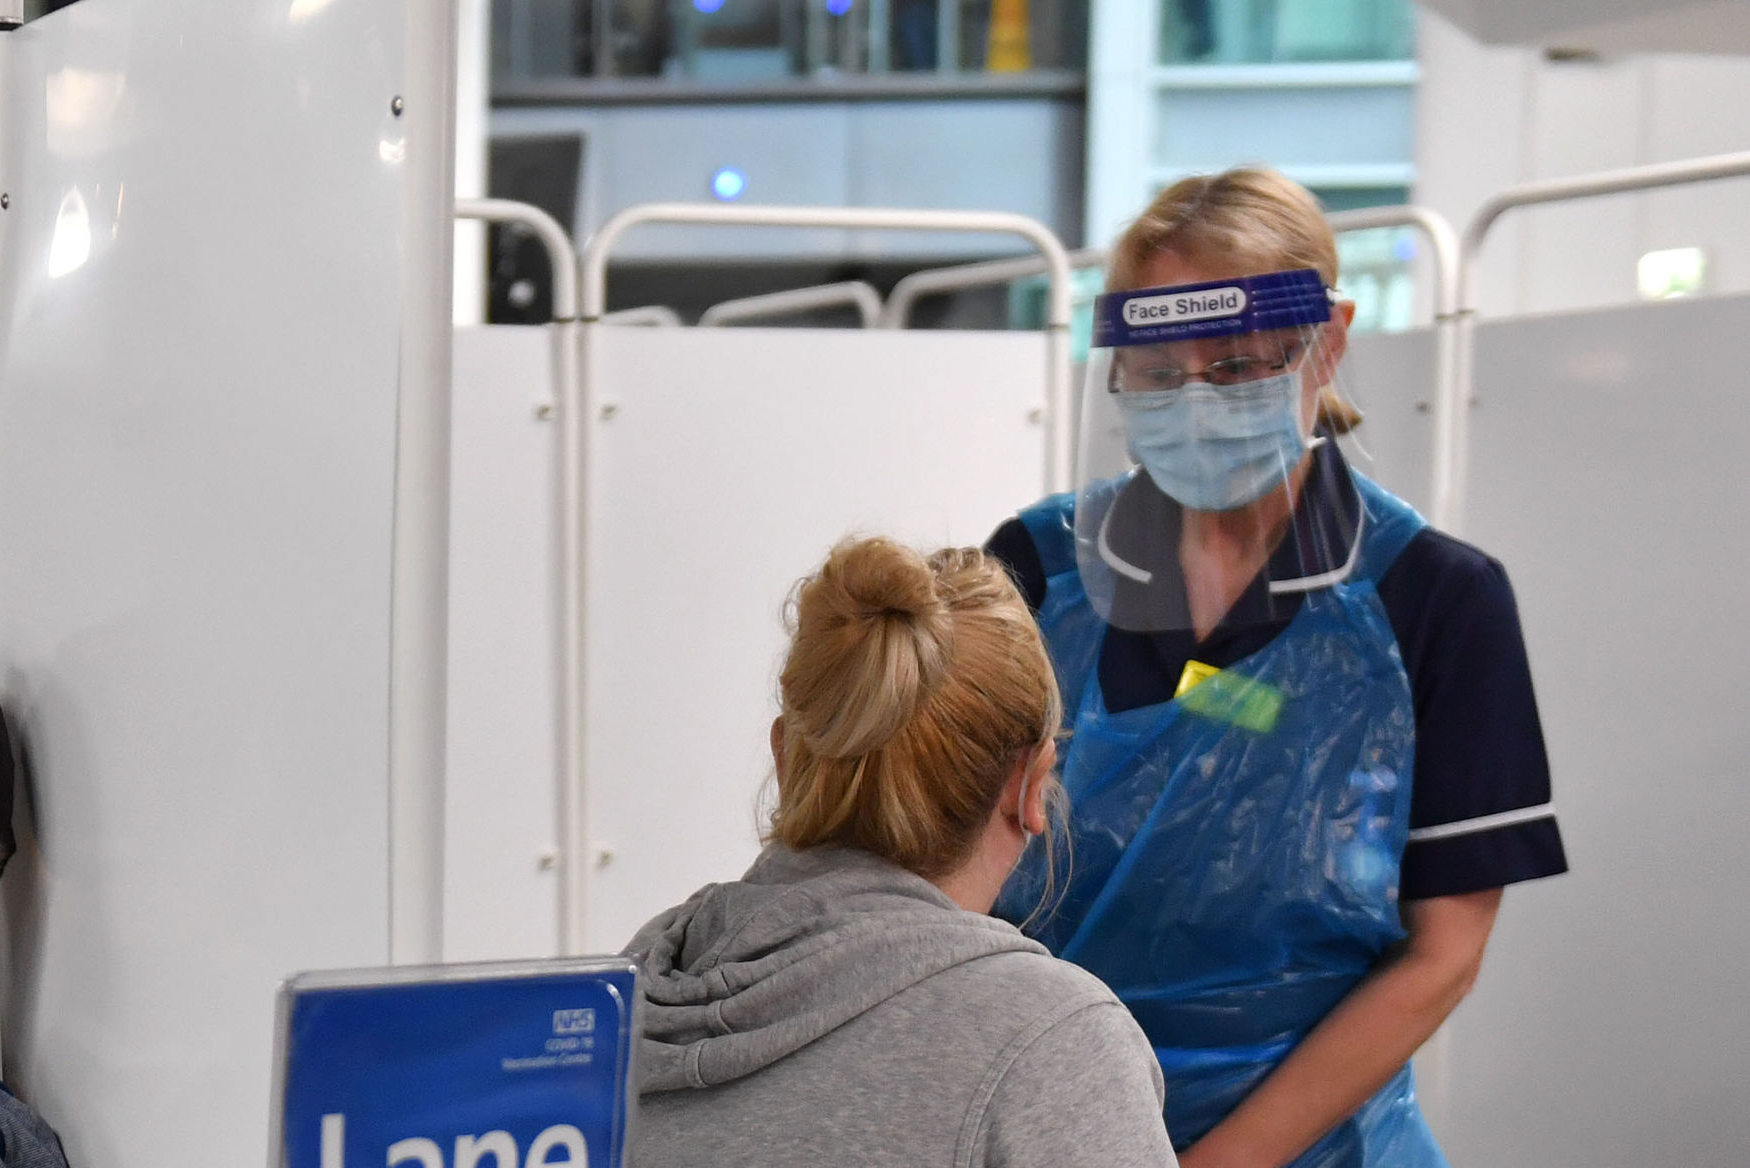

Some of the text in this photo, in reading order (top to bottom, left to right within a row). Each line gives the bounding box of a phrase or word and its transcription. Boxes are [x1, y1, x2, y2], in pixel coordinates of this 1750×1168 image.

[1129, 292, 1238, 319] Face Shield
[1189, 319, 1242, 331] PROTECTION
[557, 1012, 589, 1030] NHS
